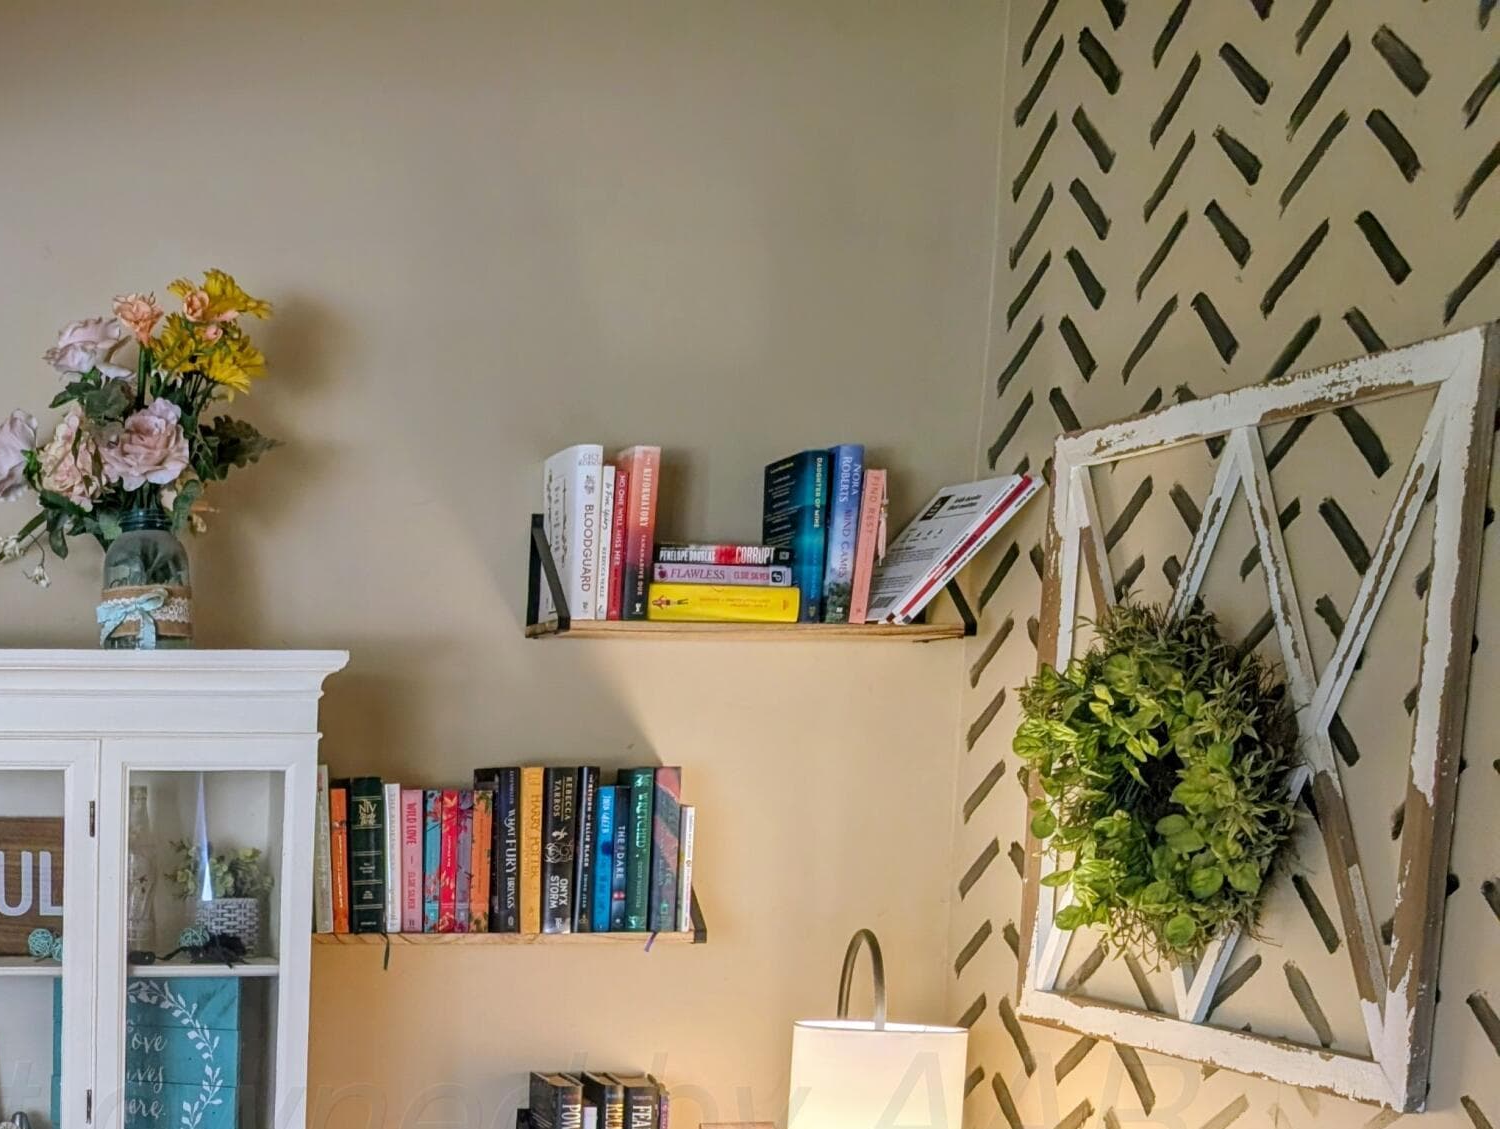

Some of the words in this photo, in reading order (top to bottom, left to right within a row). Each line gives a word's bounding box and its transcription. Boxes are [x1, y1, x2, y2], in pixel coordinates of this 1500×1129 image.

[619, 475, 626, 487] NO
[815, 457, 823, 497] DAUGHTER
[839, 457, 853, 502] ROBERTS
[850, 463, 862, 496] NORA
[867, 475, 880, 503] FIND
[640, 468, 651, 528] REFORMATORY
[814, 498, 821, 508] OF
[616, 506, 624, 526] WILL
[813, 509, 821, 528] MINE
[842, 508, 853, 537] MIND
[865, 507, 876, 534] REST
[581, 504, 594, 592] BLOODGUARD
[615, 529, 623, 548] MISS
[659, 549, 690, 561] PENELOPE
[735, 546, 776, 564] CORRUPT
[838, 541, 849, 578] GAMES
[670, 568, 726, 579] FLAWLESS
[564, 776, 573, 821] REBECCA
[406, 803, 417, 824] WILD
[504, 808, 516, 836] WHAT
[530, 794, 541, 831] HARRY
[406, 825, 417, 845] LOVE
[617, 825, 626, 843] THE
[505, 839, 517, 875] FURY
[530, 837, 541, 879] POTTER
[616, 853, 625, 879] DARE
[507, 877, 516, 909] BRINGS
[549, 875, 560, 909] STORM
[558, 878, 569, 905] ONYX
[130, 1032, 168, 1054] ove
[128, 1098, 167, 1119] ere.
